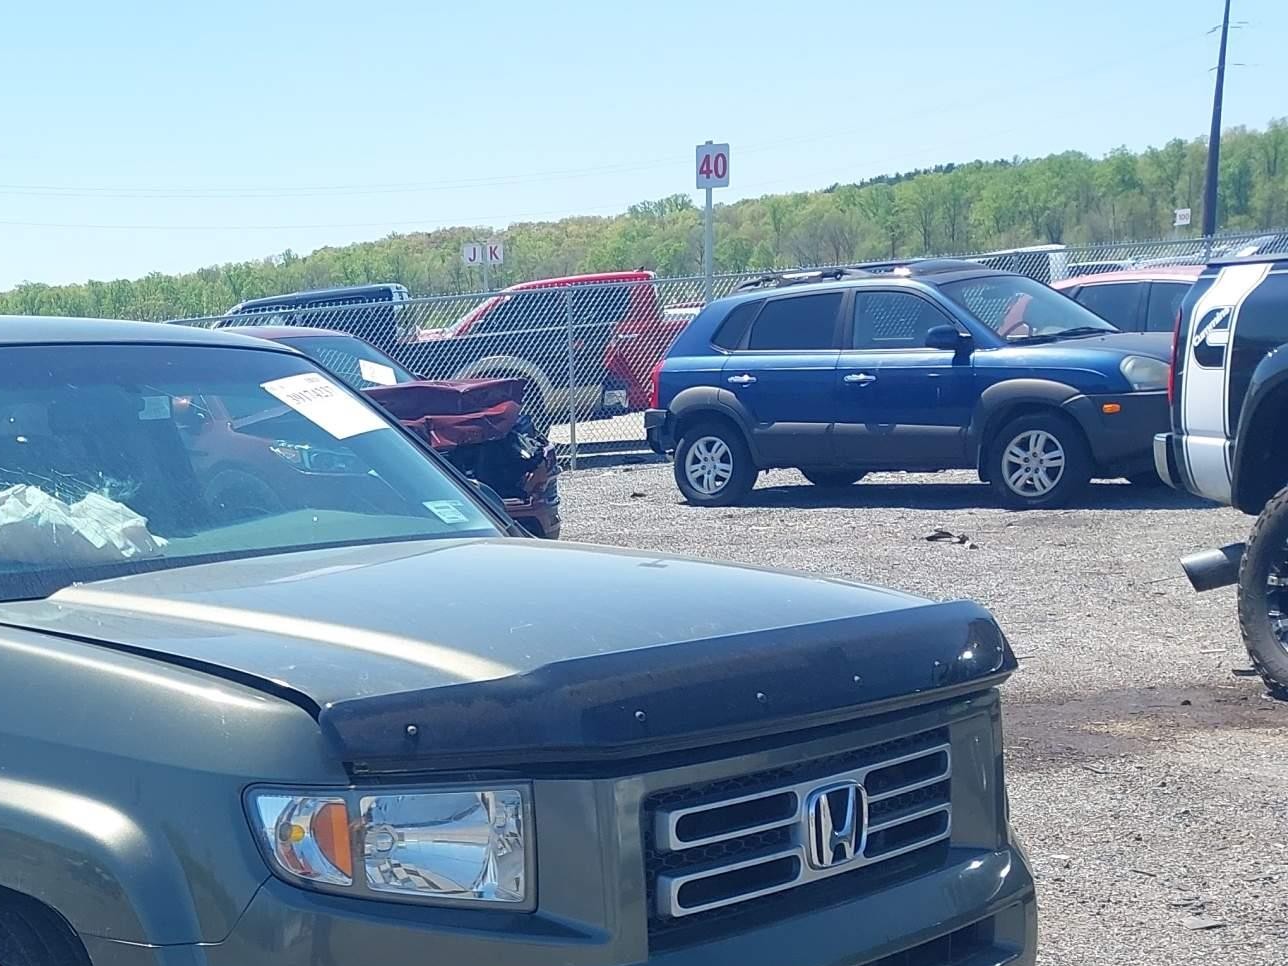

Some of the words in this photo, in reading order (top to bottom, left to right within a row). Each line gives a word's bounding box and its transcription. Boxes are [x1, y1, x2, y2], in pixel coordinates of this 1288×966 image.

[699, 152, 727, 179] 40
[468, 246, 476, 262] J
[489, 245, 499, 260] K
[1192, 306, 1231, 347] Cummins
